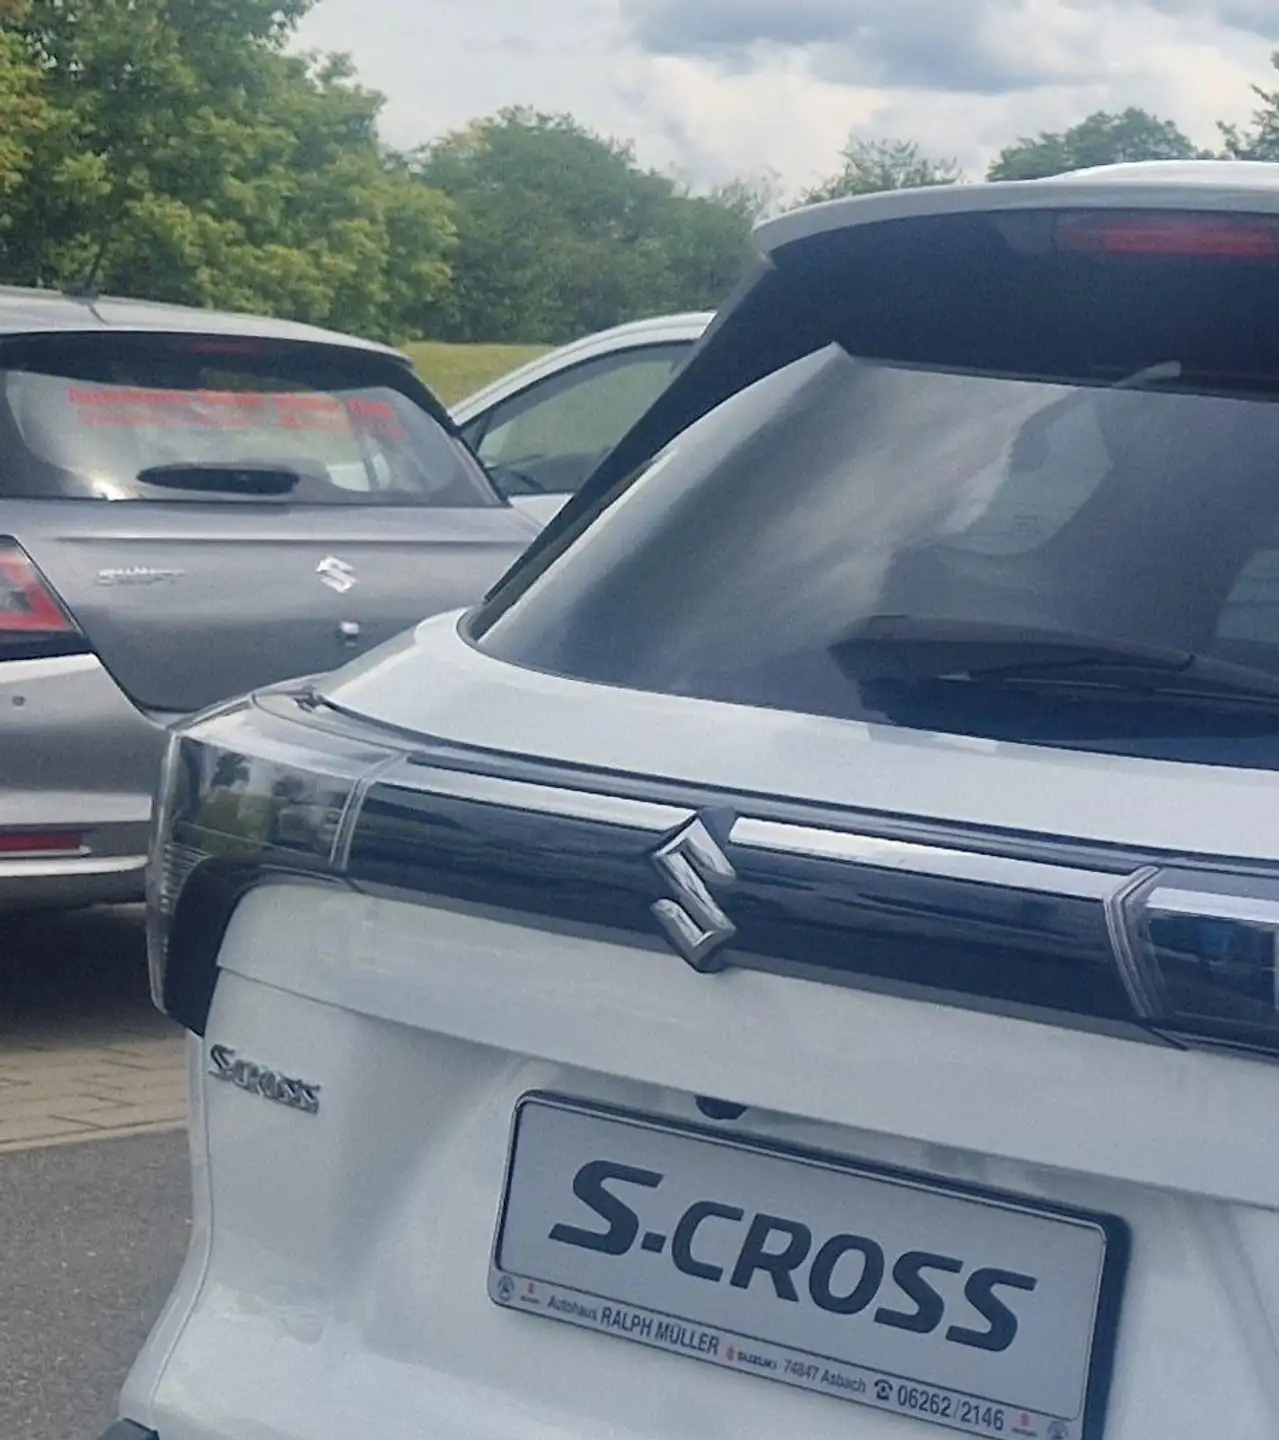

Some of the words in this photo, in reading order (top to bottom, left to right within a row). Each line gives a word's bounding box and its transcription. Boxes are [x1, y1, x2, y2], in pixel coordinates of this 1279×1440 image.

[546, 1295, 598, 1322] Autohaus
[600, 1306, 652, 1338] RALPH
[654, 1322, 720, 1355] MÜLLER
[820, 1369, 867, 1394] Asbach
[897, 1384, 1004, 1431] 06262/2146
